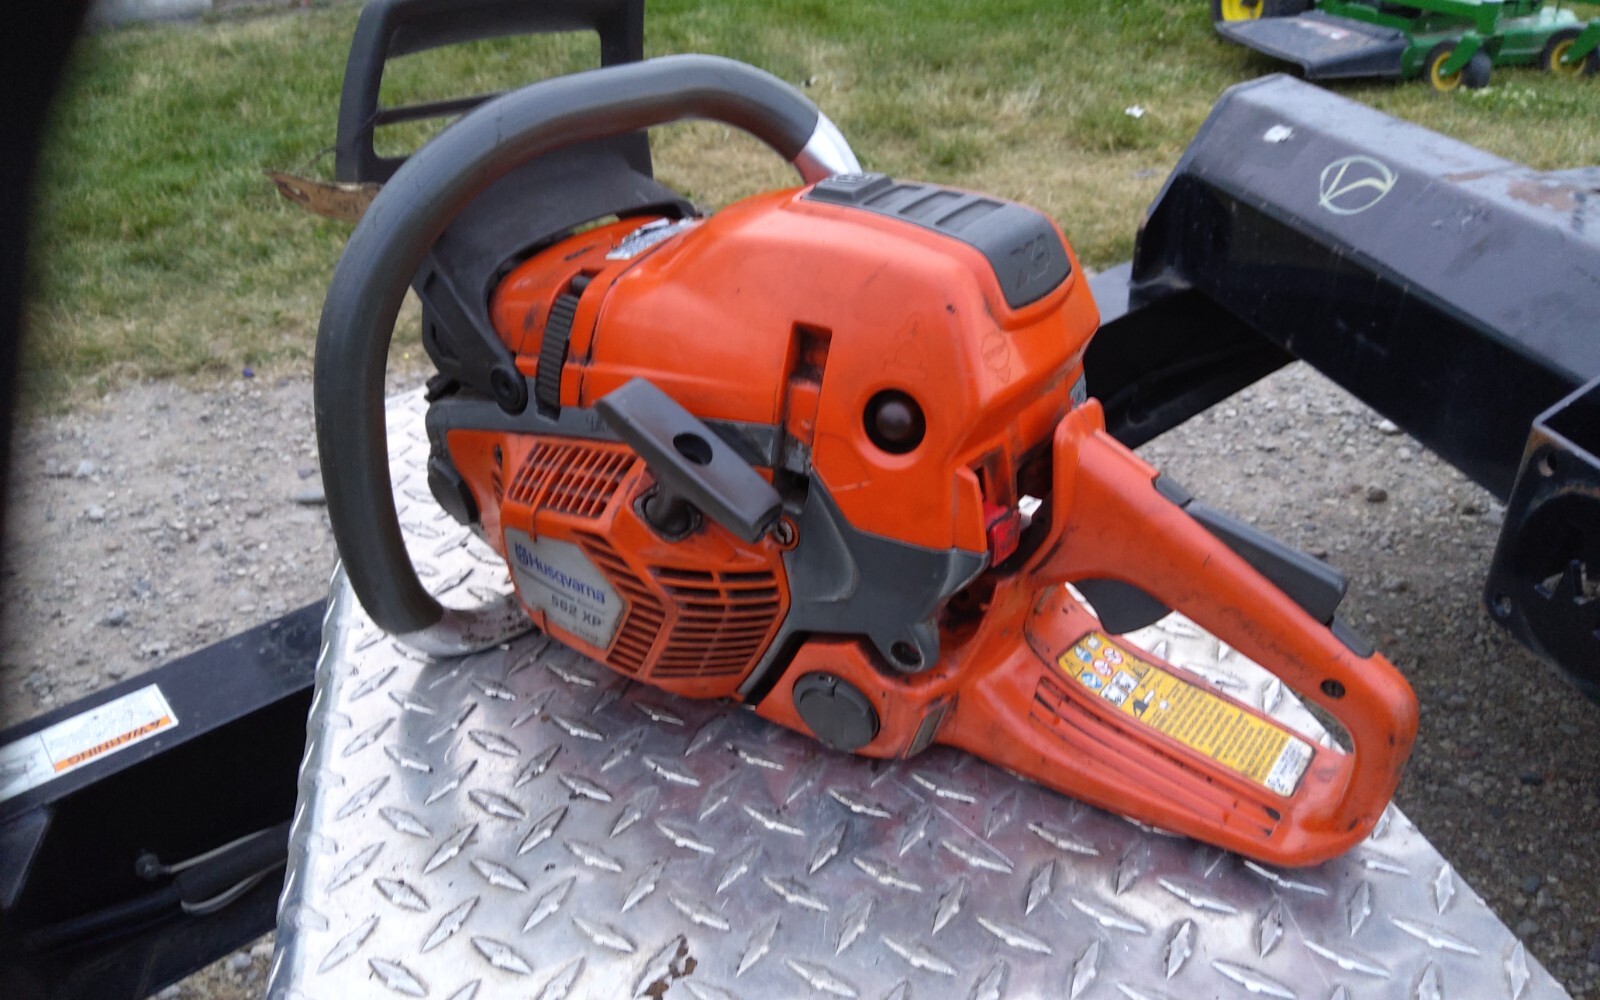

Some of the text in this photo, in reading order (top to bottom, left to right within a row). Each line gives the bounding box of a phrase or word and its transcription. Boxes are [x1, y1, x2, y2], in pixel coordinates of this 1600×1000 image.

[528, 551, 606, 604] Husqvarna
[583, 611, 602, 627] XP
[67, 724, 149, 766] WARNING
